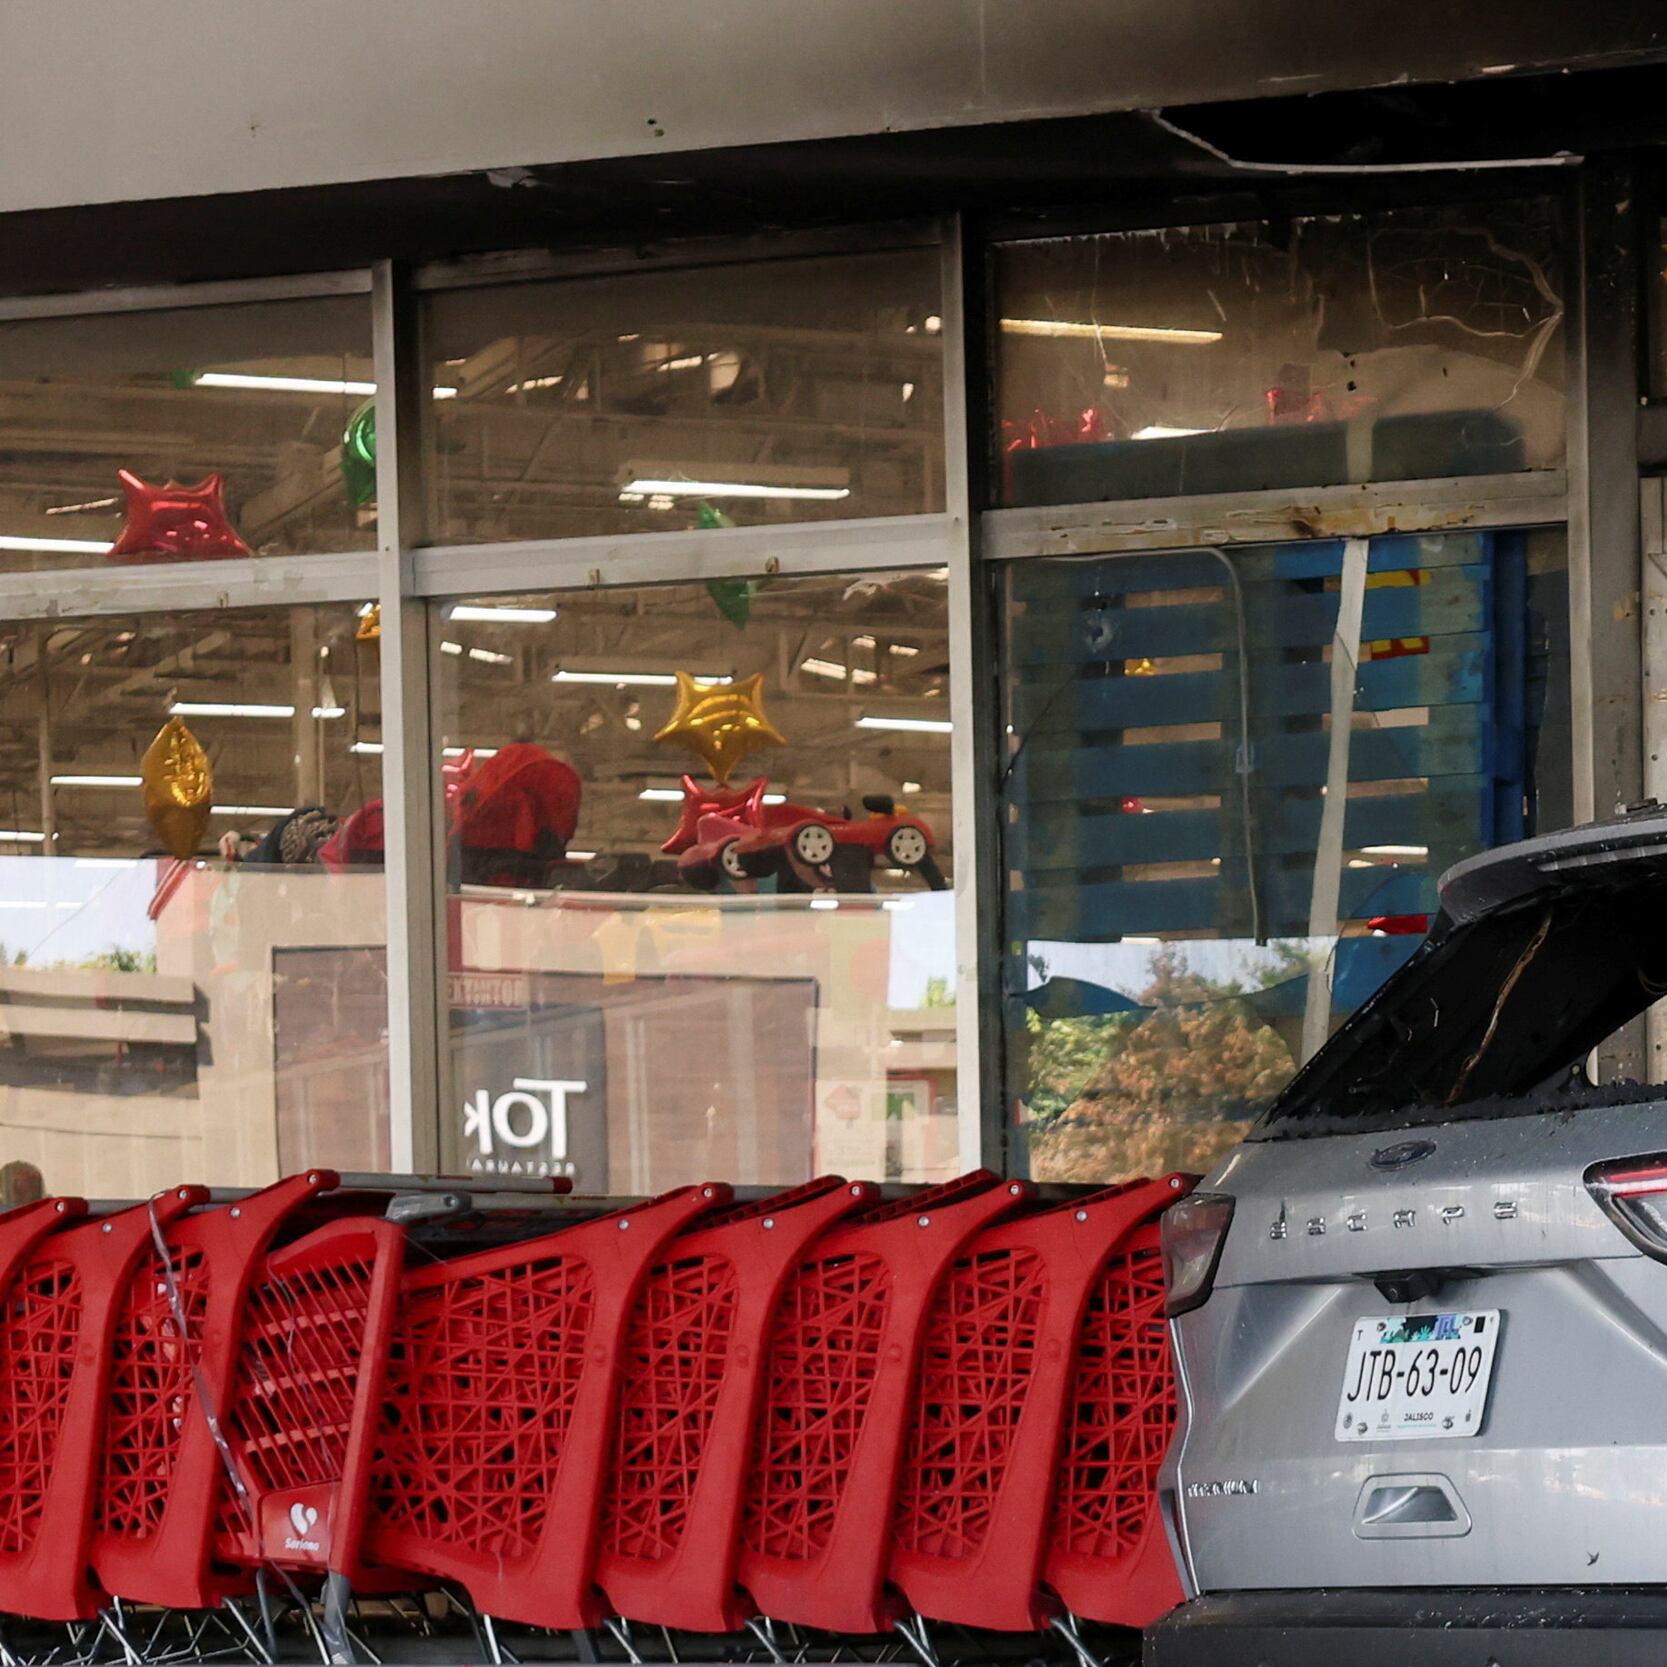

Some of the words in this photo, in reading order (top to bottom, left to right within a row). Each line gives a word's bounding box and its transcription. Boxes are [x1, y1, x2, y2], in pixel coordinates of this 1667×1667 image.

[1346, 1345, 1484, 1403] JTB-63-09
[1403, 1411, 1434, 1422] JALISCO
[285, 1537, 320, 1551] Soriana
